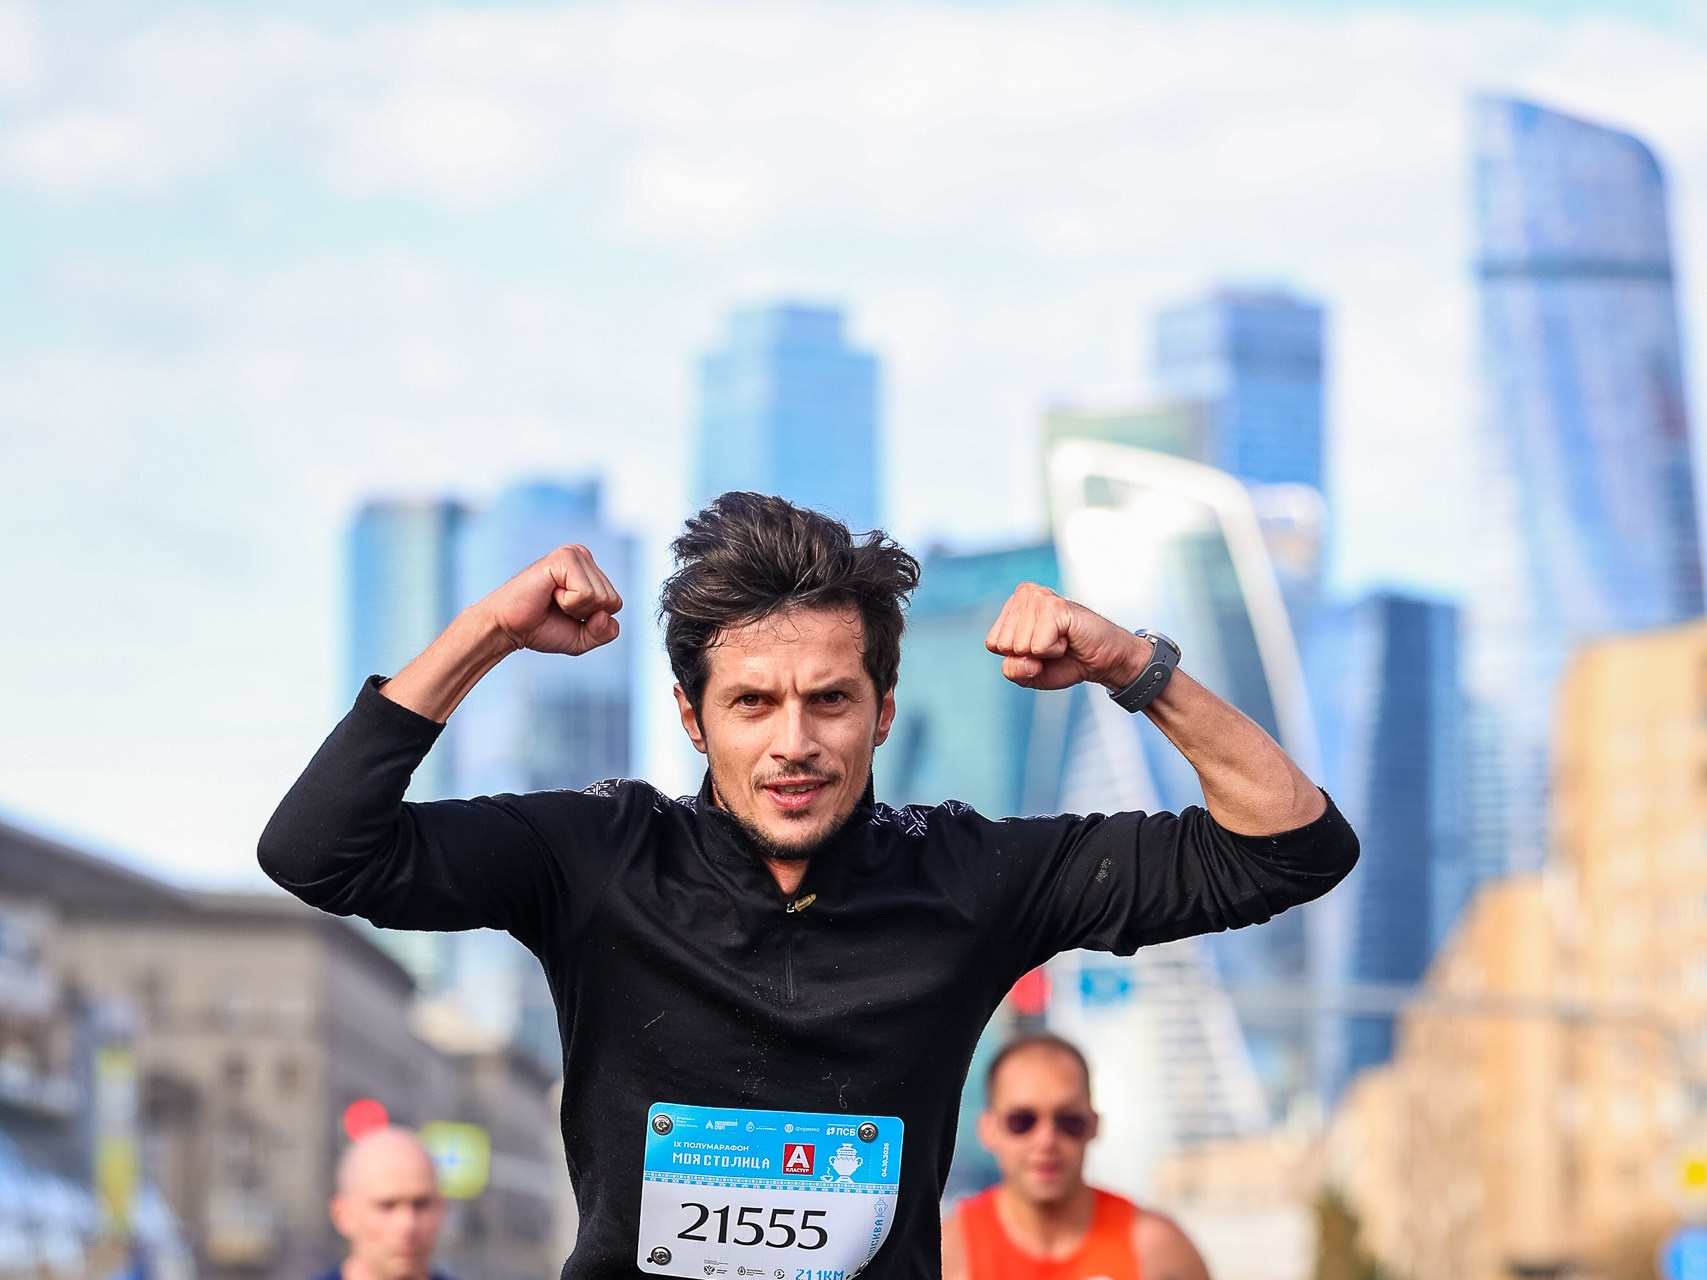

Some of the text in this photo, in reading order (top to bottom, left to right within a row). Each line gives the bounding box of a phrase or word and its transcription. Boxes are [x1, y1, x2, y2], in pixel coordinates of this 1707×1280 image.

[836, 1127, 856, 1136] ПСБ
[684, 1142, 749, 1151] ПОЛУМАРАФОН
[672, 1152, 770, 1169] МОЯ СТОЛИЦА
[786, 1146, 810, 1168] А
[677, 1202, 828, 1250] 21555
